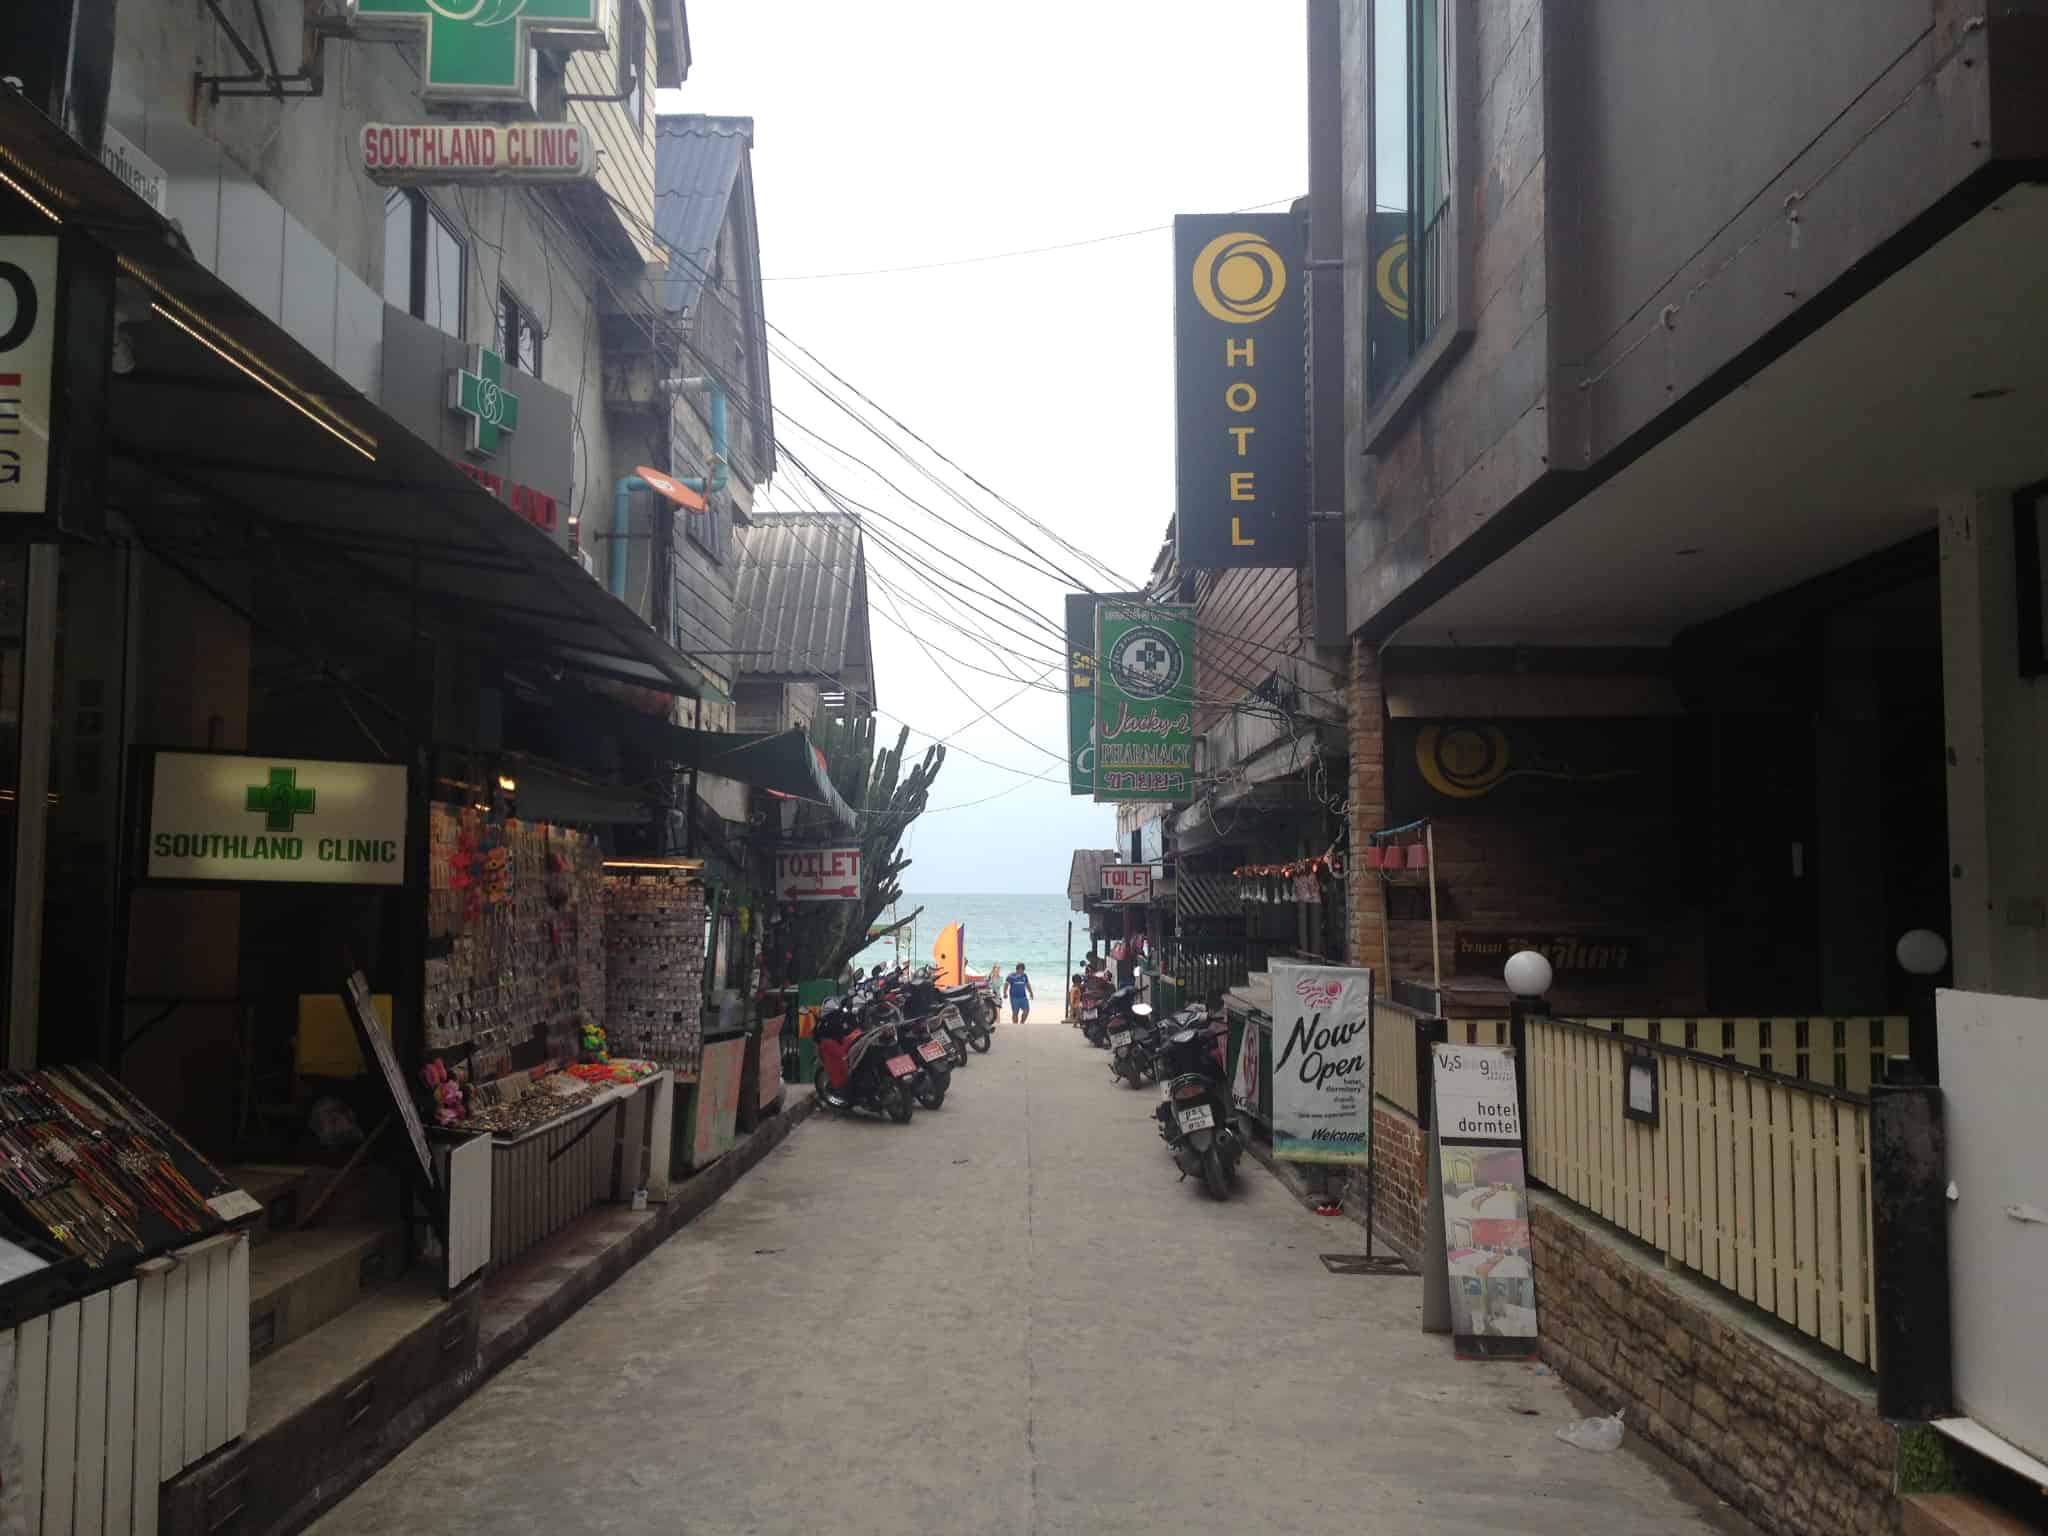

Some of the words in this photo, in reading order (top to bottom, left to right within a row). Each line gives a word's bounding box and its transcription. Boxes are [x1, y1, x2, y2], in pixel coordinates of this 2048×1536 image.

[364, 127, 496, 167] SOUTHLAND
[506, 127, 578, 166] CLINIC
[1225, 338, 1257, 546] HOTEL
[1101, 743, 1191, 765] PHARMACY
[153, 833, 303, 861] SOUTHLAND
[318, 838, 397, 863] CLINIC
[778, 851, 863, 878] TOILET
[1104, 871, 1150, 886] TOILET
[1273, 1012, 1366, 1075] Now
[1299, 1051, 1366, 1091] Open
[1477, 1101, 1516, 1117] hotel
[1311, 1128, 1366, 1143] Welcome
[1458, 1118, 1518, 1133] dormtel
